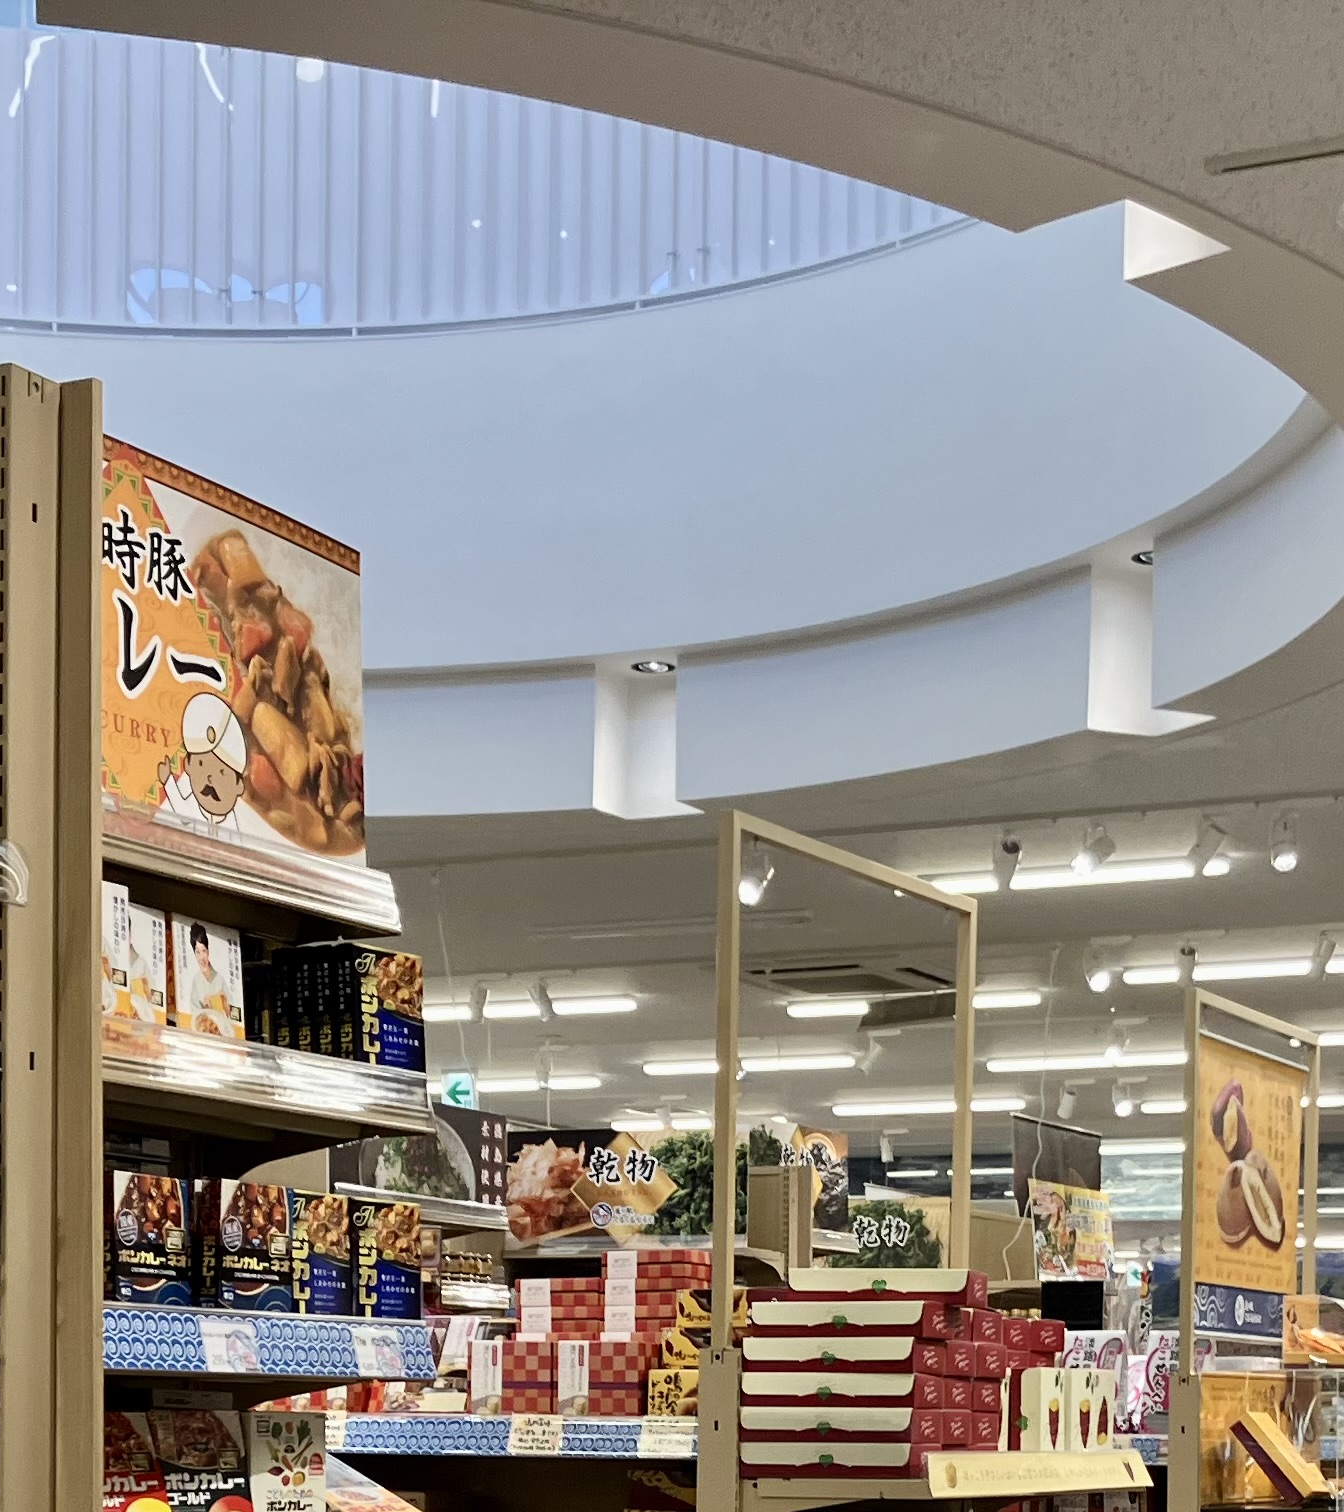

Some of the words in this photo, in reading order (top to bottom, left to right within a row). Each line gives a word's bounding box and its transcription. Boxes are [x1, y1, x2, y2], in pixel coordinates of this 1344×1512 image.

[588, 1146, 659, 1185] 乾物
[852, 1215, 910, 1248] 乾物
[165, 1472, 246, 1491] ボンカレー
[167, 1490, 211, 1507] ゴールド
[266, 1500, 313, 1512] ボンカレー
